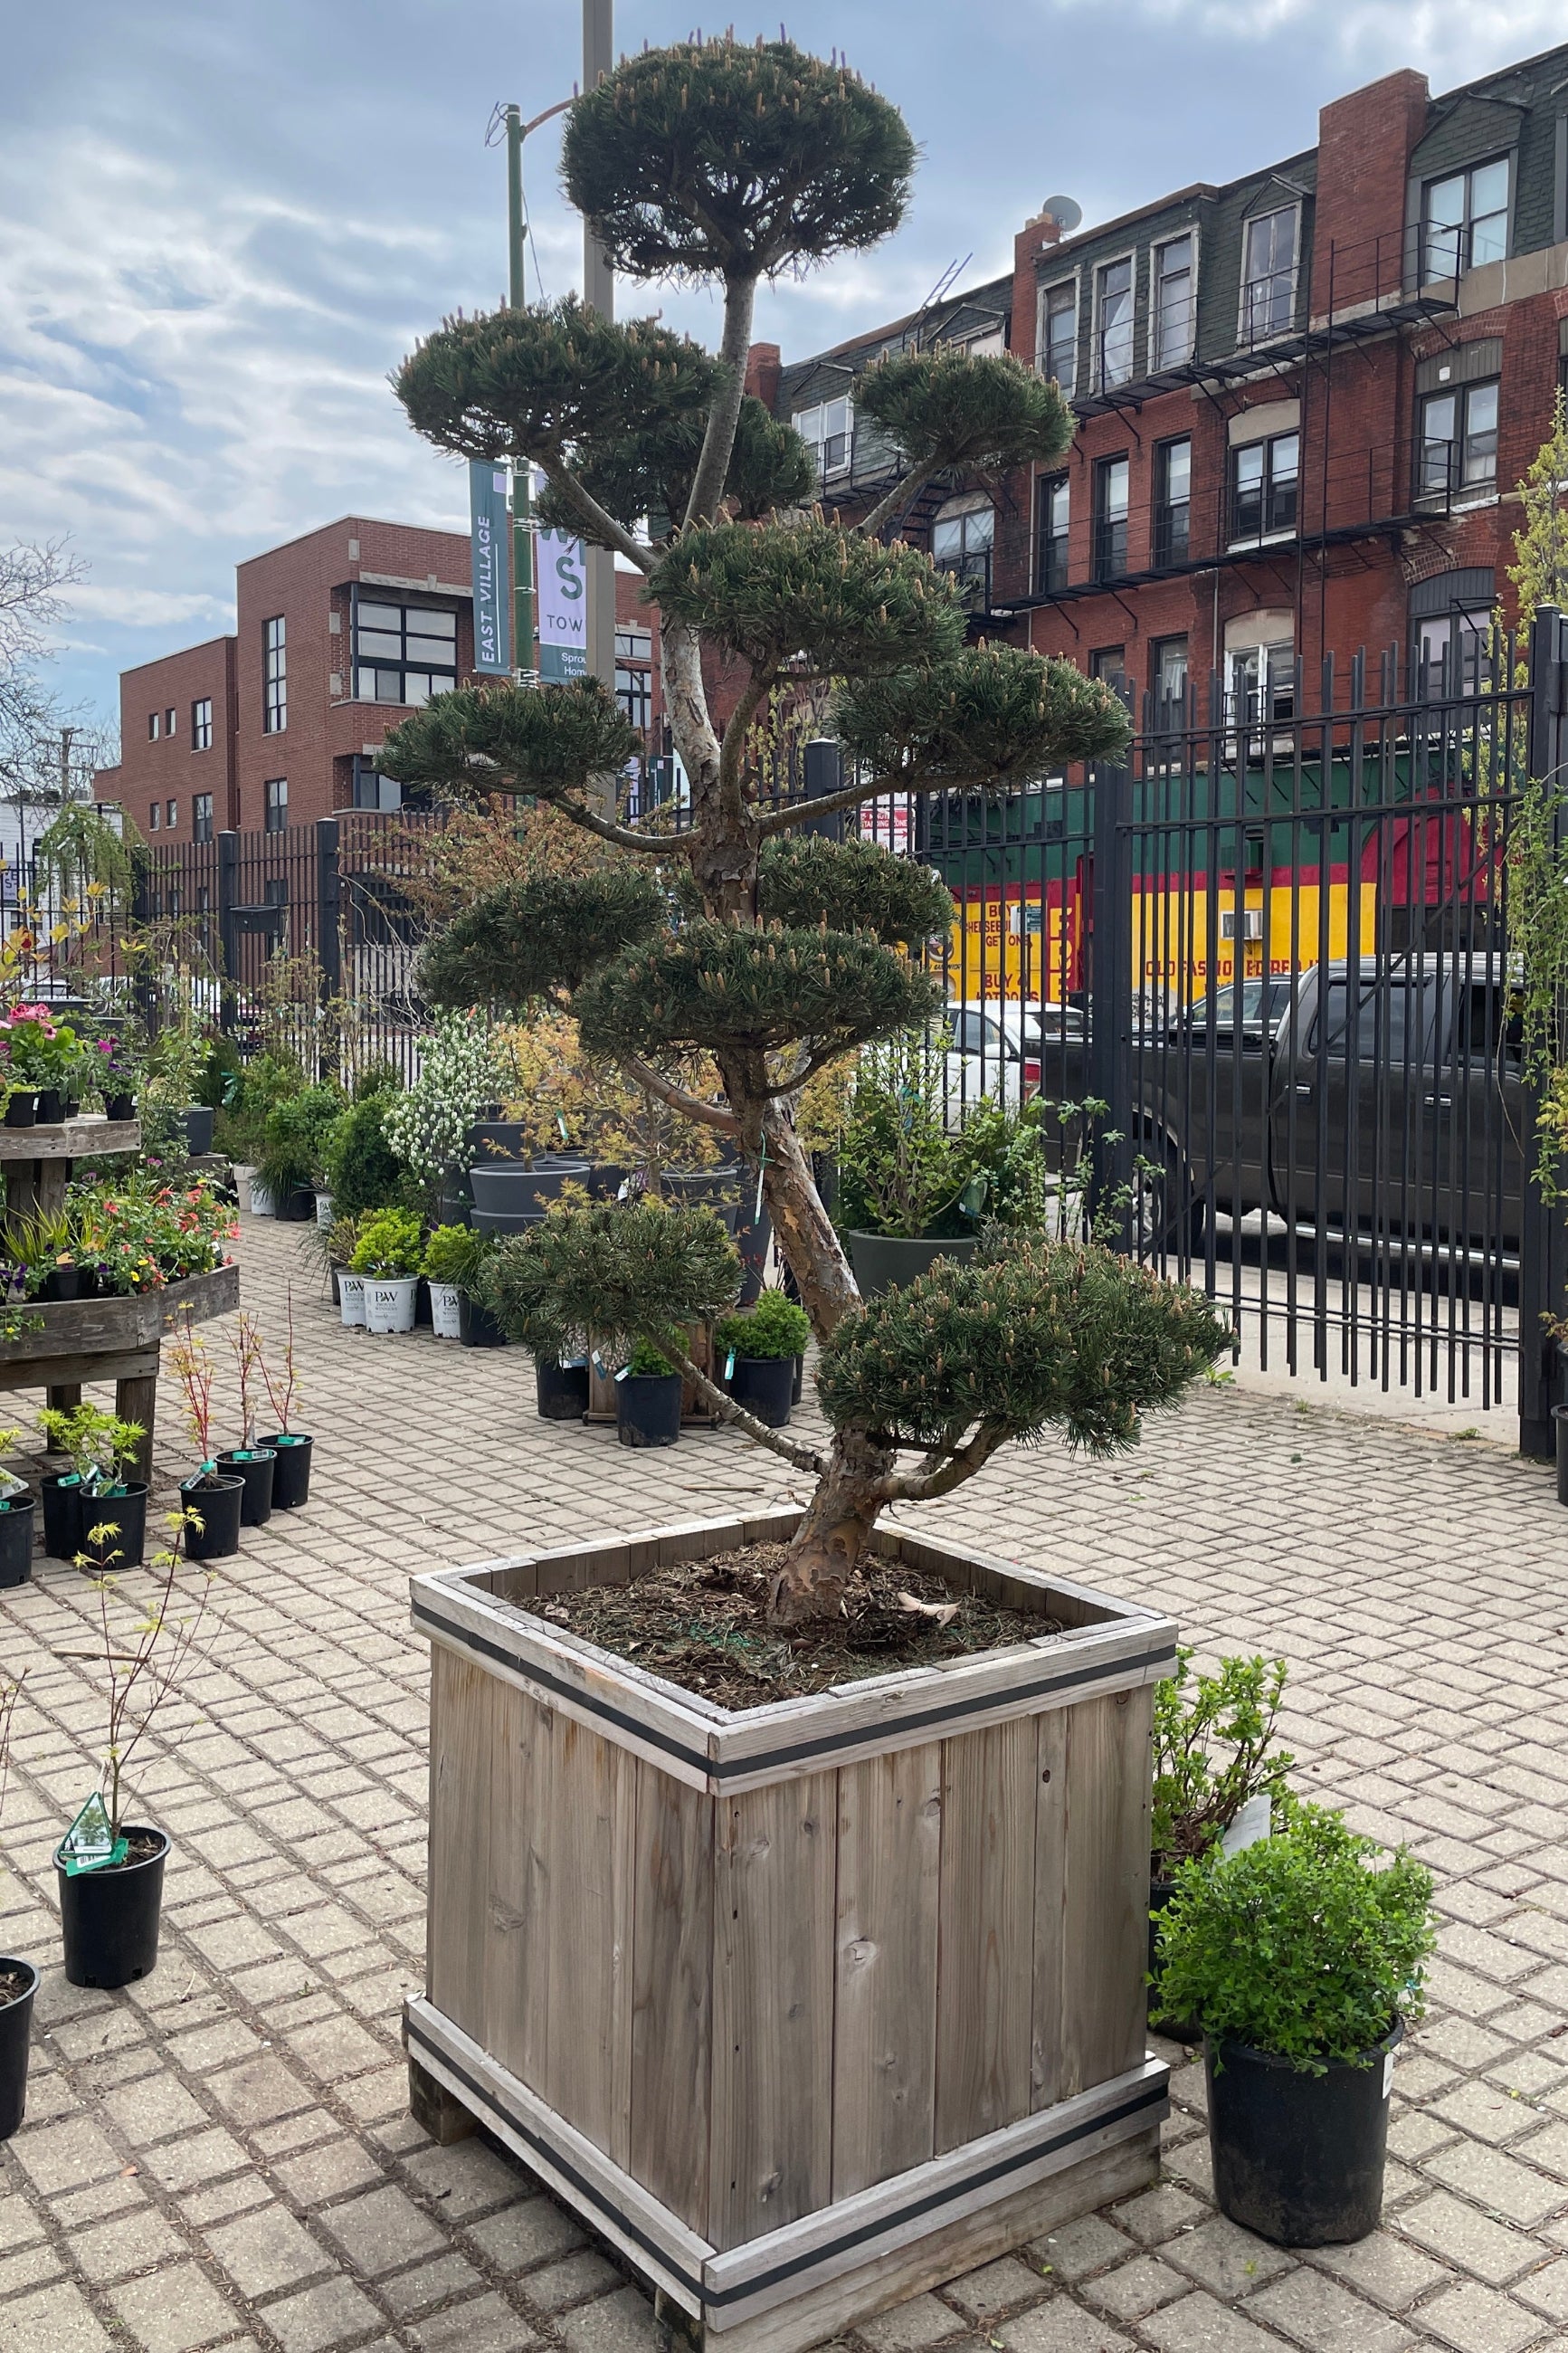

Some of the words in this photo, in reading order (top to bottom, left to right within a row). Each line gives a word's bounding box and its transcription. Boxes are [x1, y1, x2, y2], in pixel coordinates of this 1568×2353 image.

[478, 516, 492, 602] VILLAGE
[546, 614, 586, 633] TOW
[480, 611, 495, 662] EAST
[561, 652, 586, 664] Sprou
[564, 665, 586, 677] Hom
[989, 905, 1011, 918] BY
[986, 936, 1002, 948] GE
[1145, 960, 1175, 976] OLD
[1270, 960, 1302, 975] RE
[984, 974, 1012, 988] BUY
[375, 1291, 398, 1302] PW
